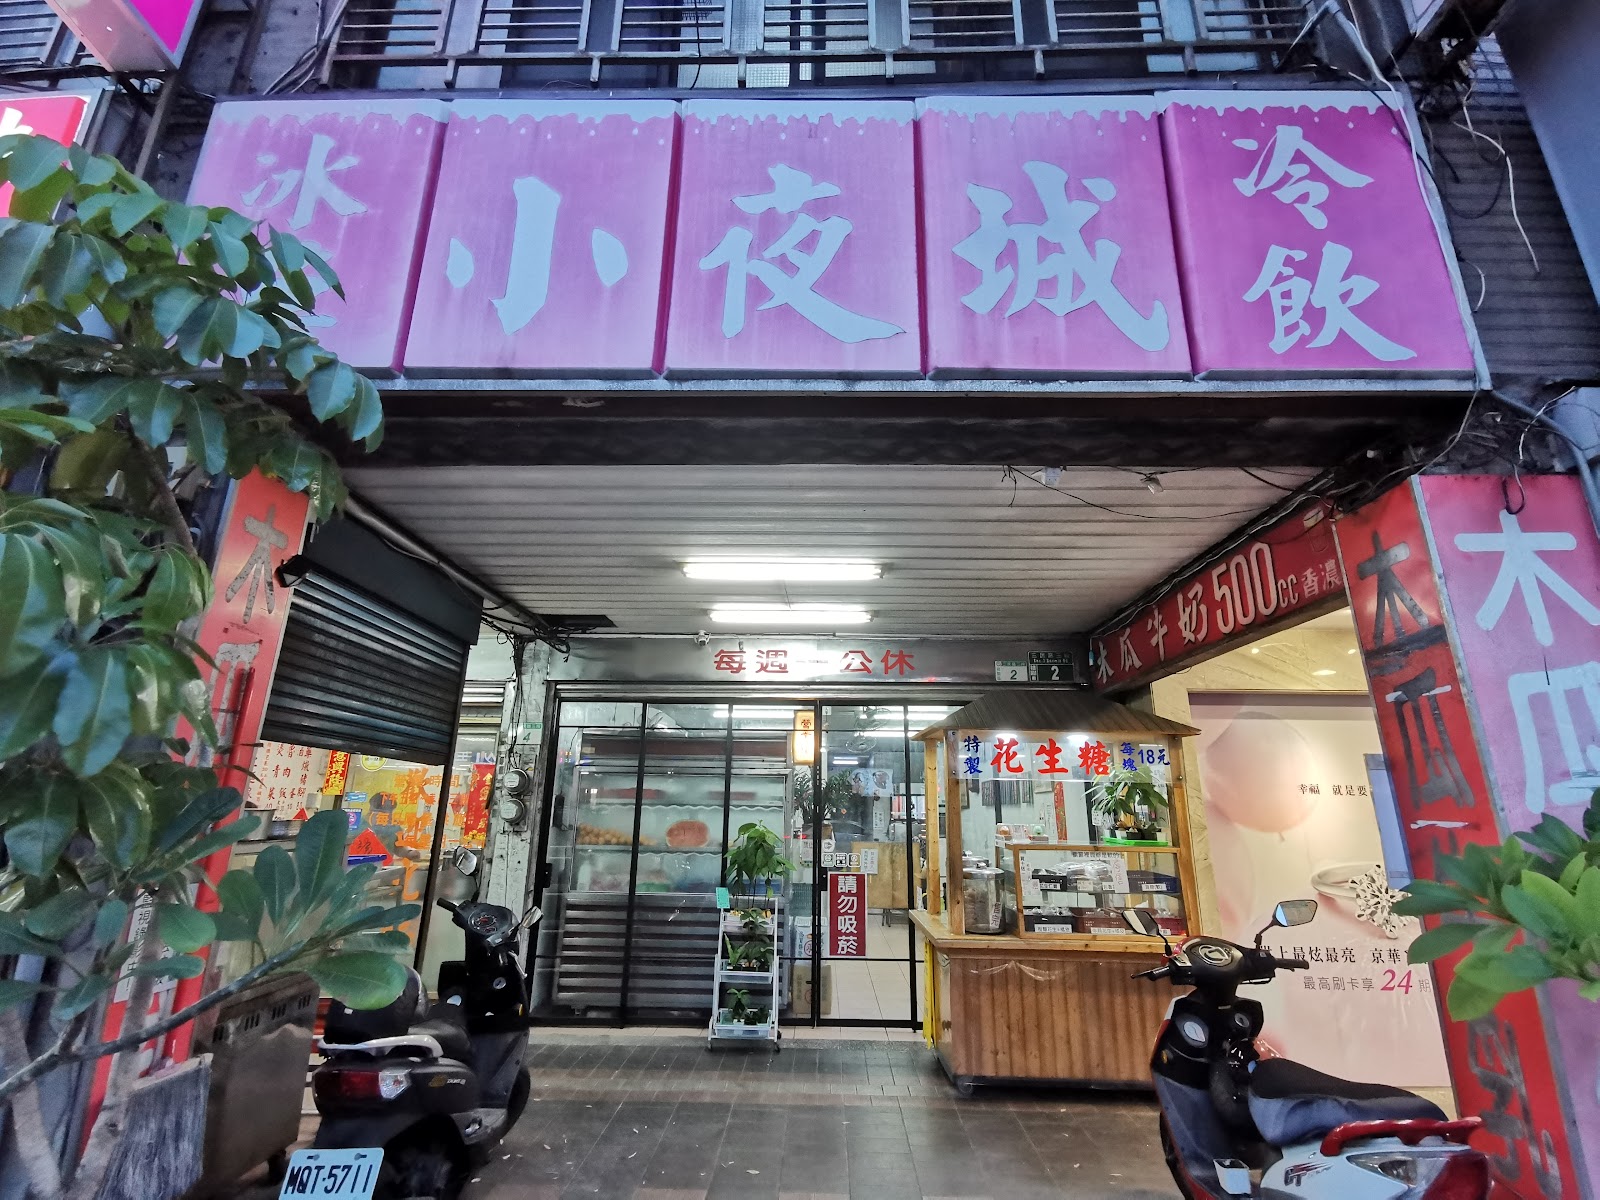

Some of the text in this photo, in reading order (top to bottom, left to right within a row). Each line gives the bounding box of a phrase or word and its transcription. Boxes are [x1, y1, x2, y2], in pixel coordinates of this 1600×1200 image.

[1232, 124, 1417, 362] 冷飲
[1010, 669, 1018, 680] 2
[1051, 665, 1060, 680] 2
[522, 732, 531, 742] 4
[964, 735, 1170, 776] 特製 花生糖 每塊 18元
[1298, 783, 1369, 797] 幸福 就是要
[836, 875, 859, 955] 請勿吸菸
[1303, 969, 1432, 995] 最高刷卡享 24 期
